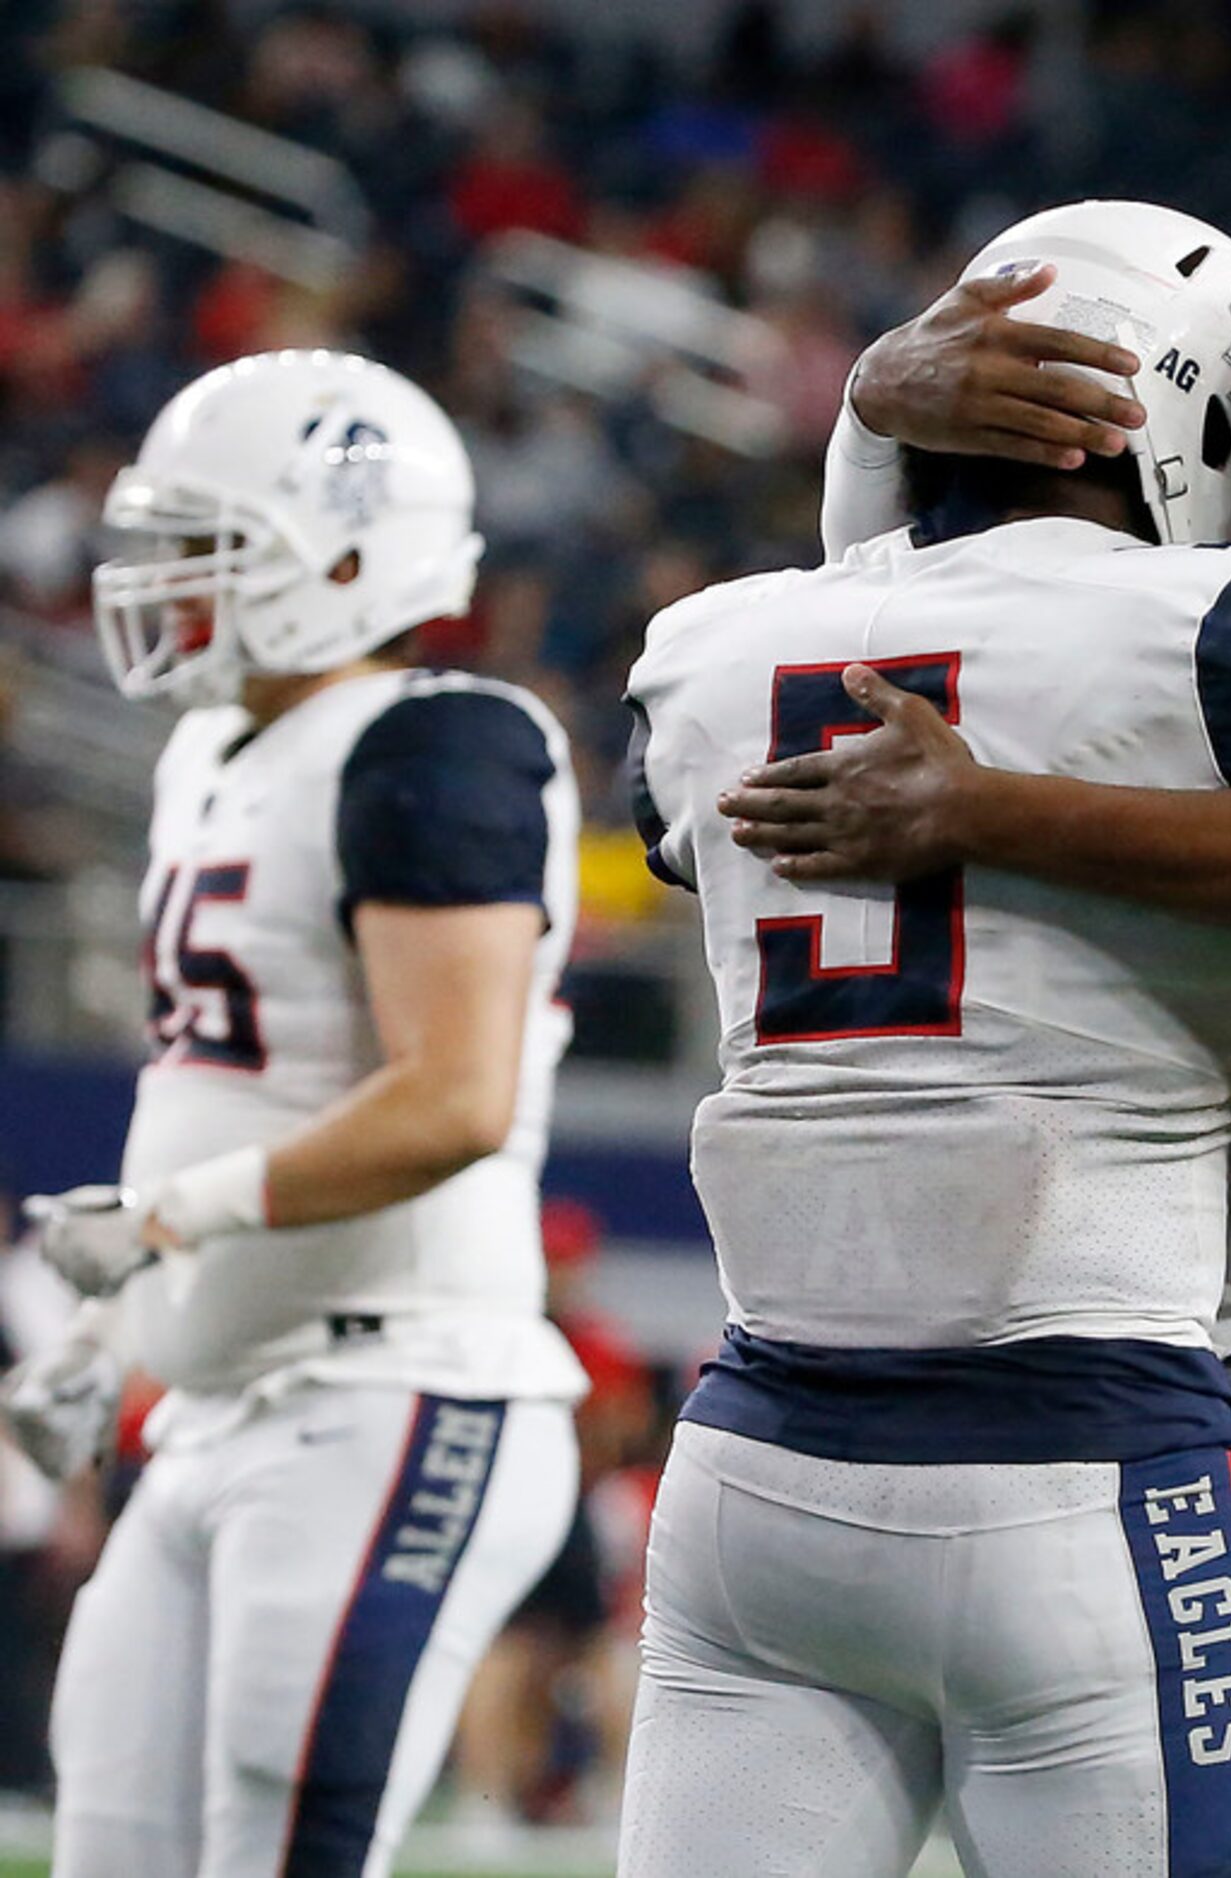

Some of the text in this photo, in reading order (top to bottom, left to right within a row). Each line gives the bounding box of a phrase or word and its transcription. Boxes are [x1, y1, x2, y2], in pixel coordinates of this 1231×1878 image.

[1154, 348, 1201, 394] AG
[755, 650, 966, 1046] 5
[379, 1402, 500, 1596] ALLEN
